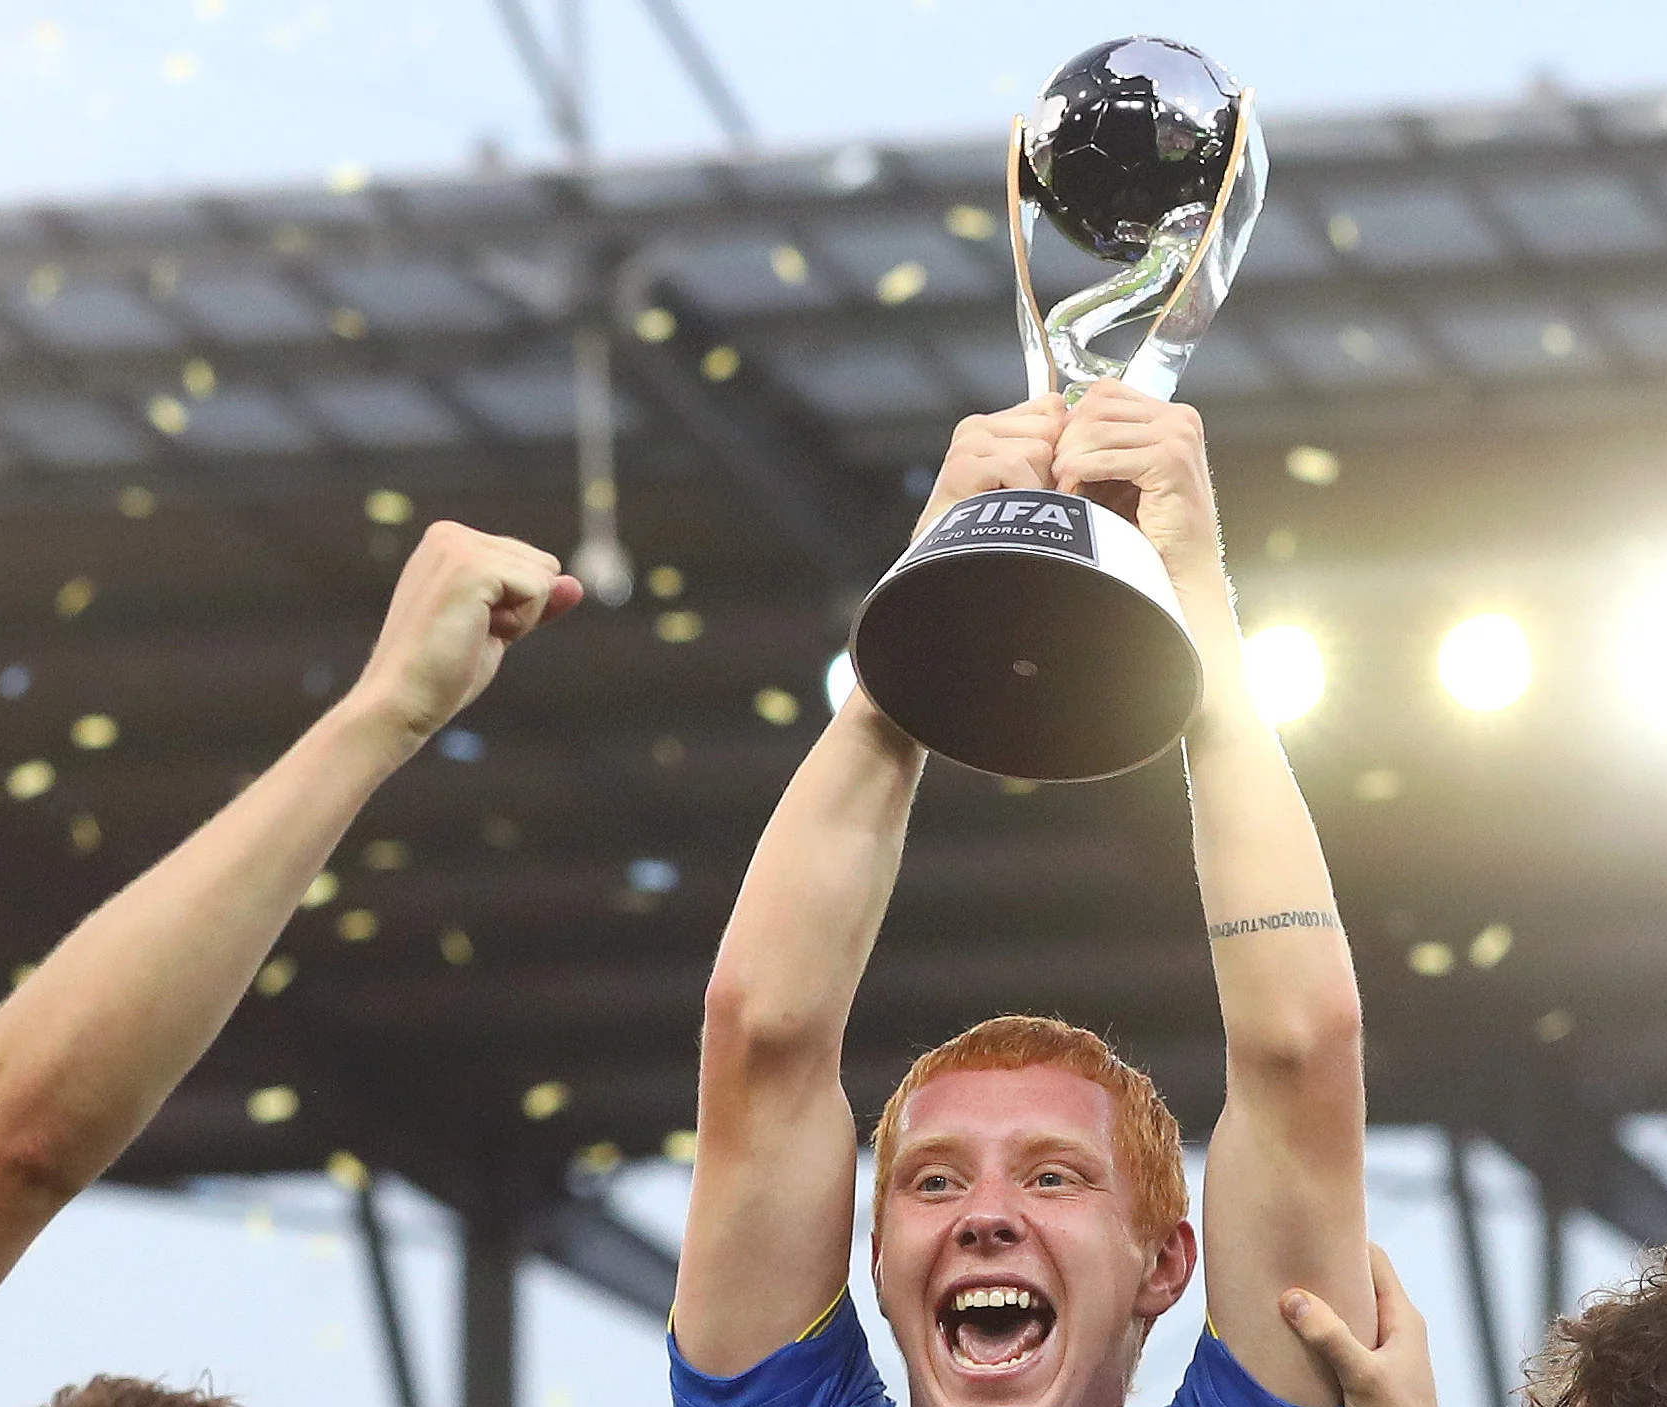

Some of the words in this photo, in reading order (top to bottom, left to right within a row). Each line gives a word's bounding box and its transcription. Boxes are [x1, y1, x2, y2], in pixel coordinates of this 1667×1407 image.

[939, 501, 1073, 532] FIFA
[971, 526, 1034, 537] WORLD
[1038, 530, 1074, 542] CUP
